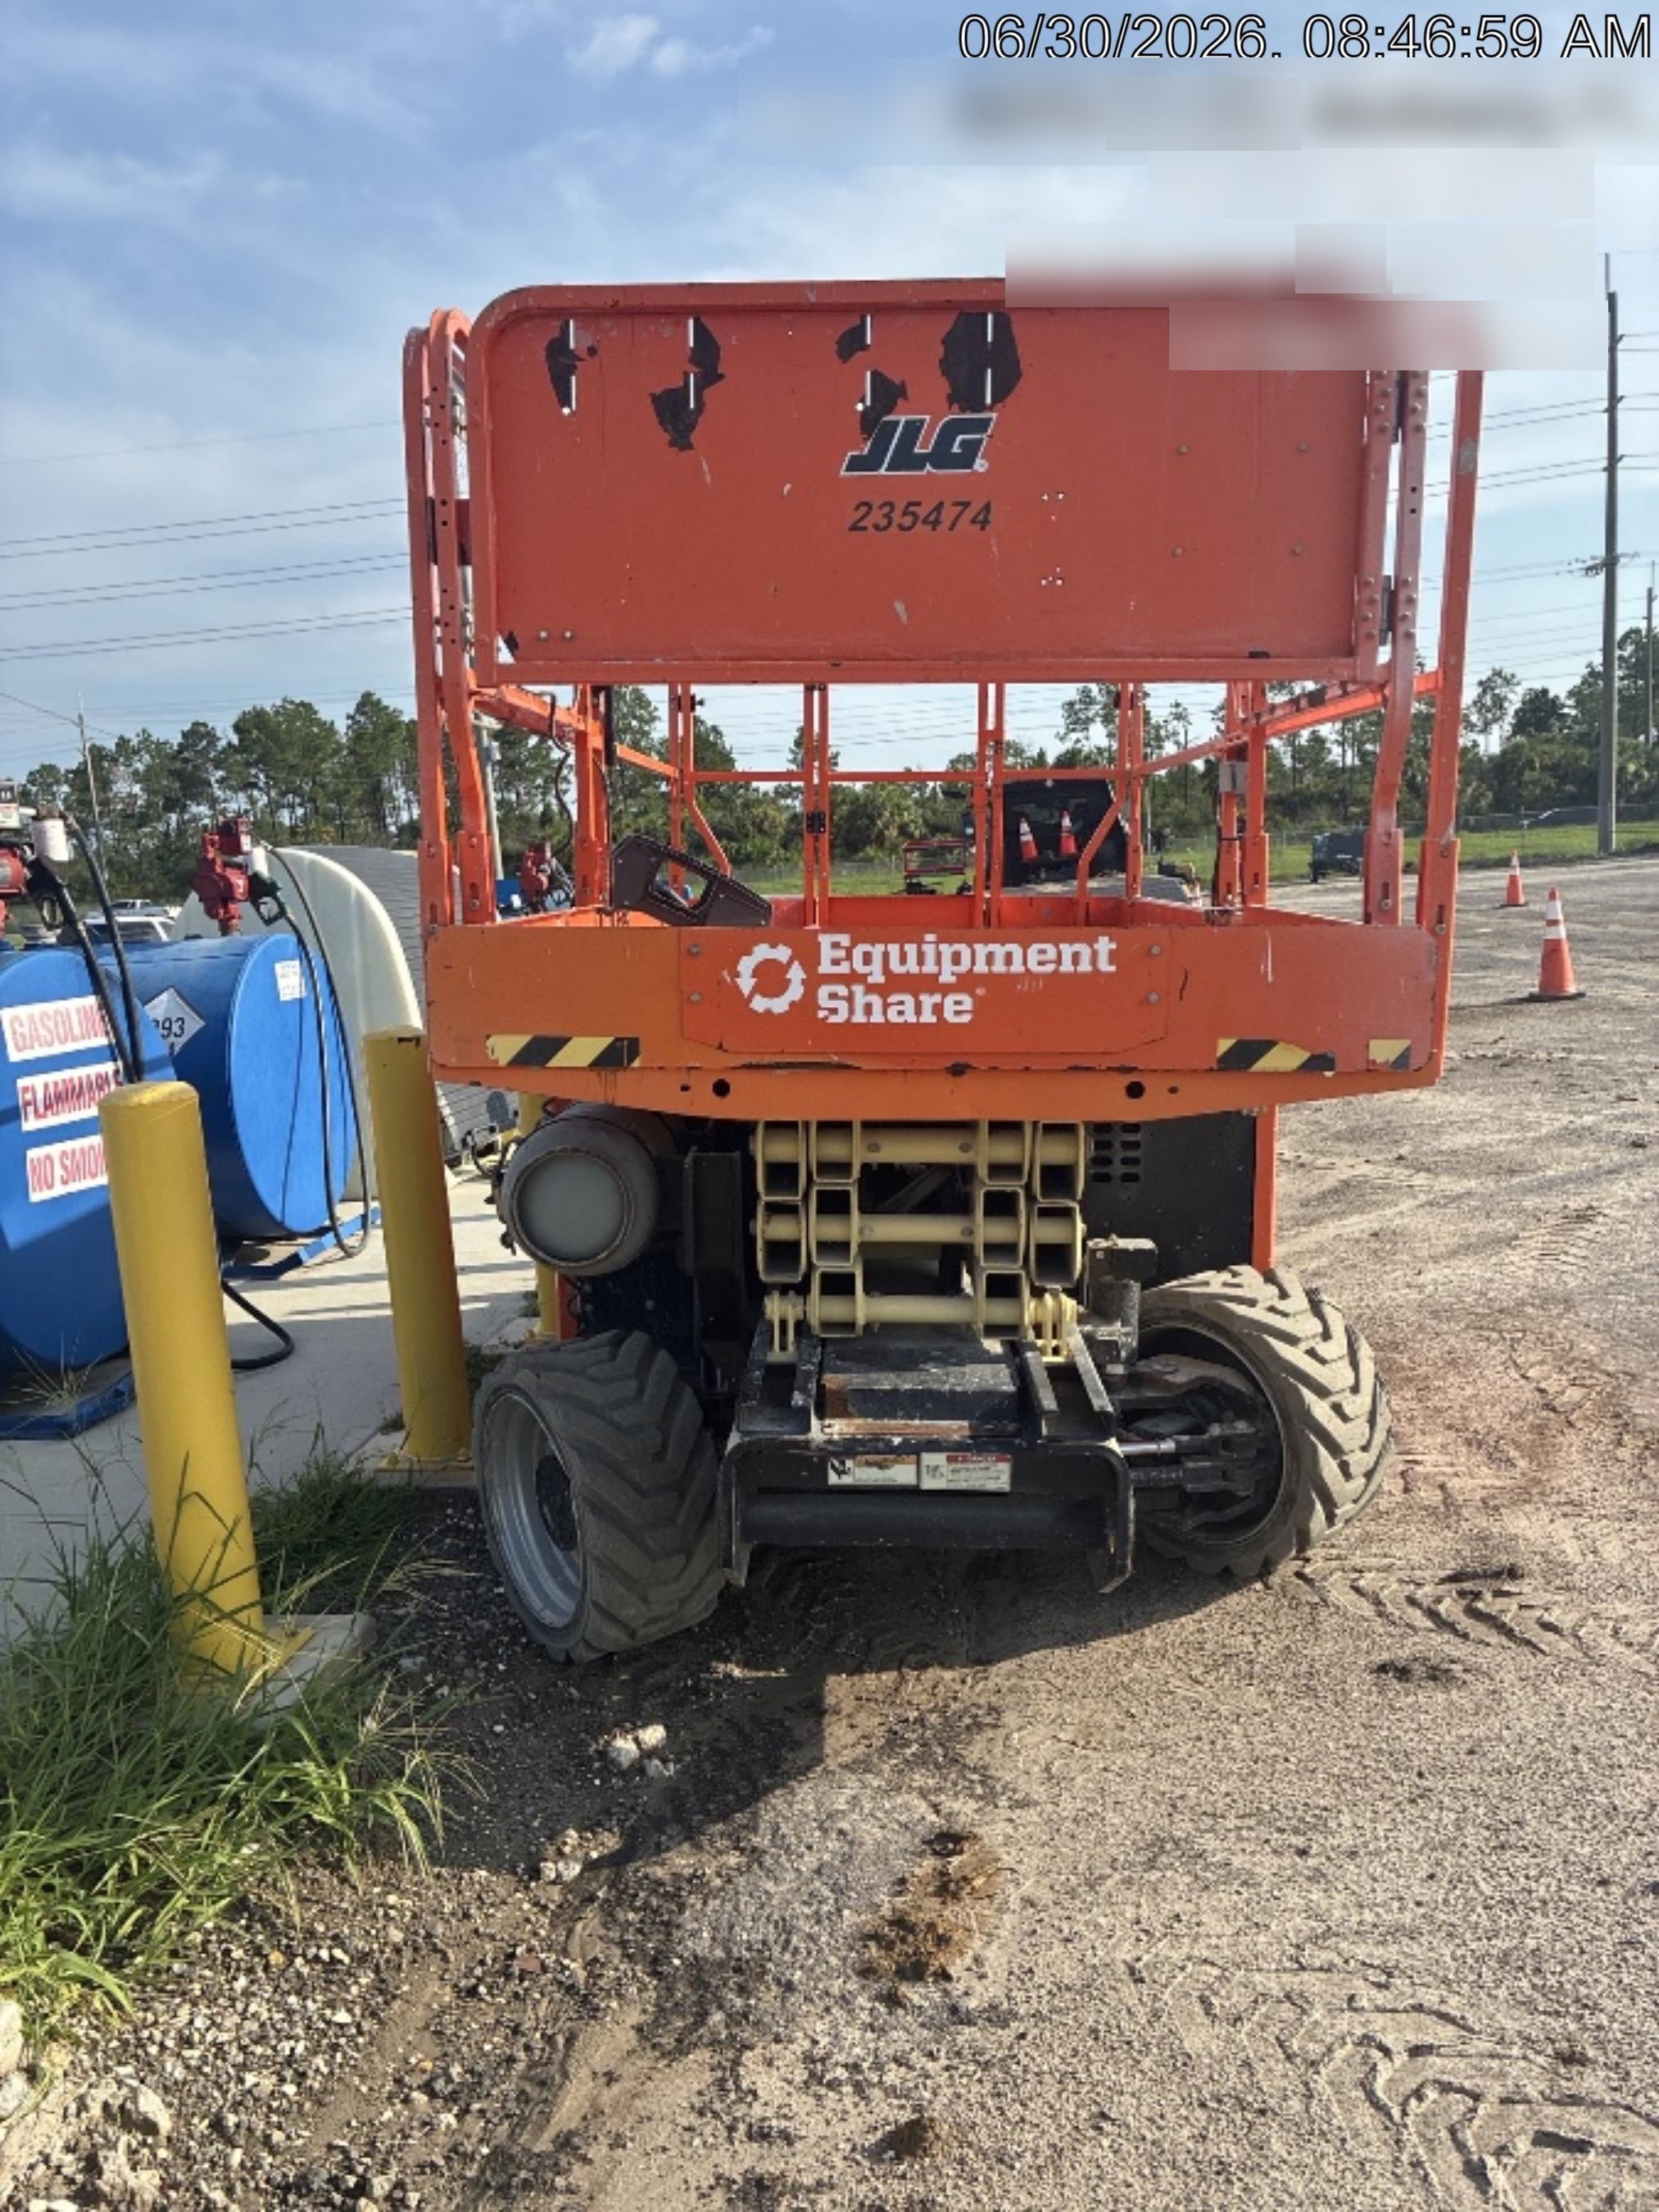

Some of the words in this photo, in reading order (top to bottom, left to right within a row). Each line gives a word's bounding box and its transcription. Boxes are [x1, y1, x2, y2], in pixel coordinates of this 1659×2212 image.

[840, 413, 998, 477] JLG
[848, 501, 992, 532] 235474
[818, 934, 1117, 984] Equipment
[818, 985, 974, 1024] Share
[29, 1153, 55, 1193] NO
